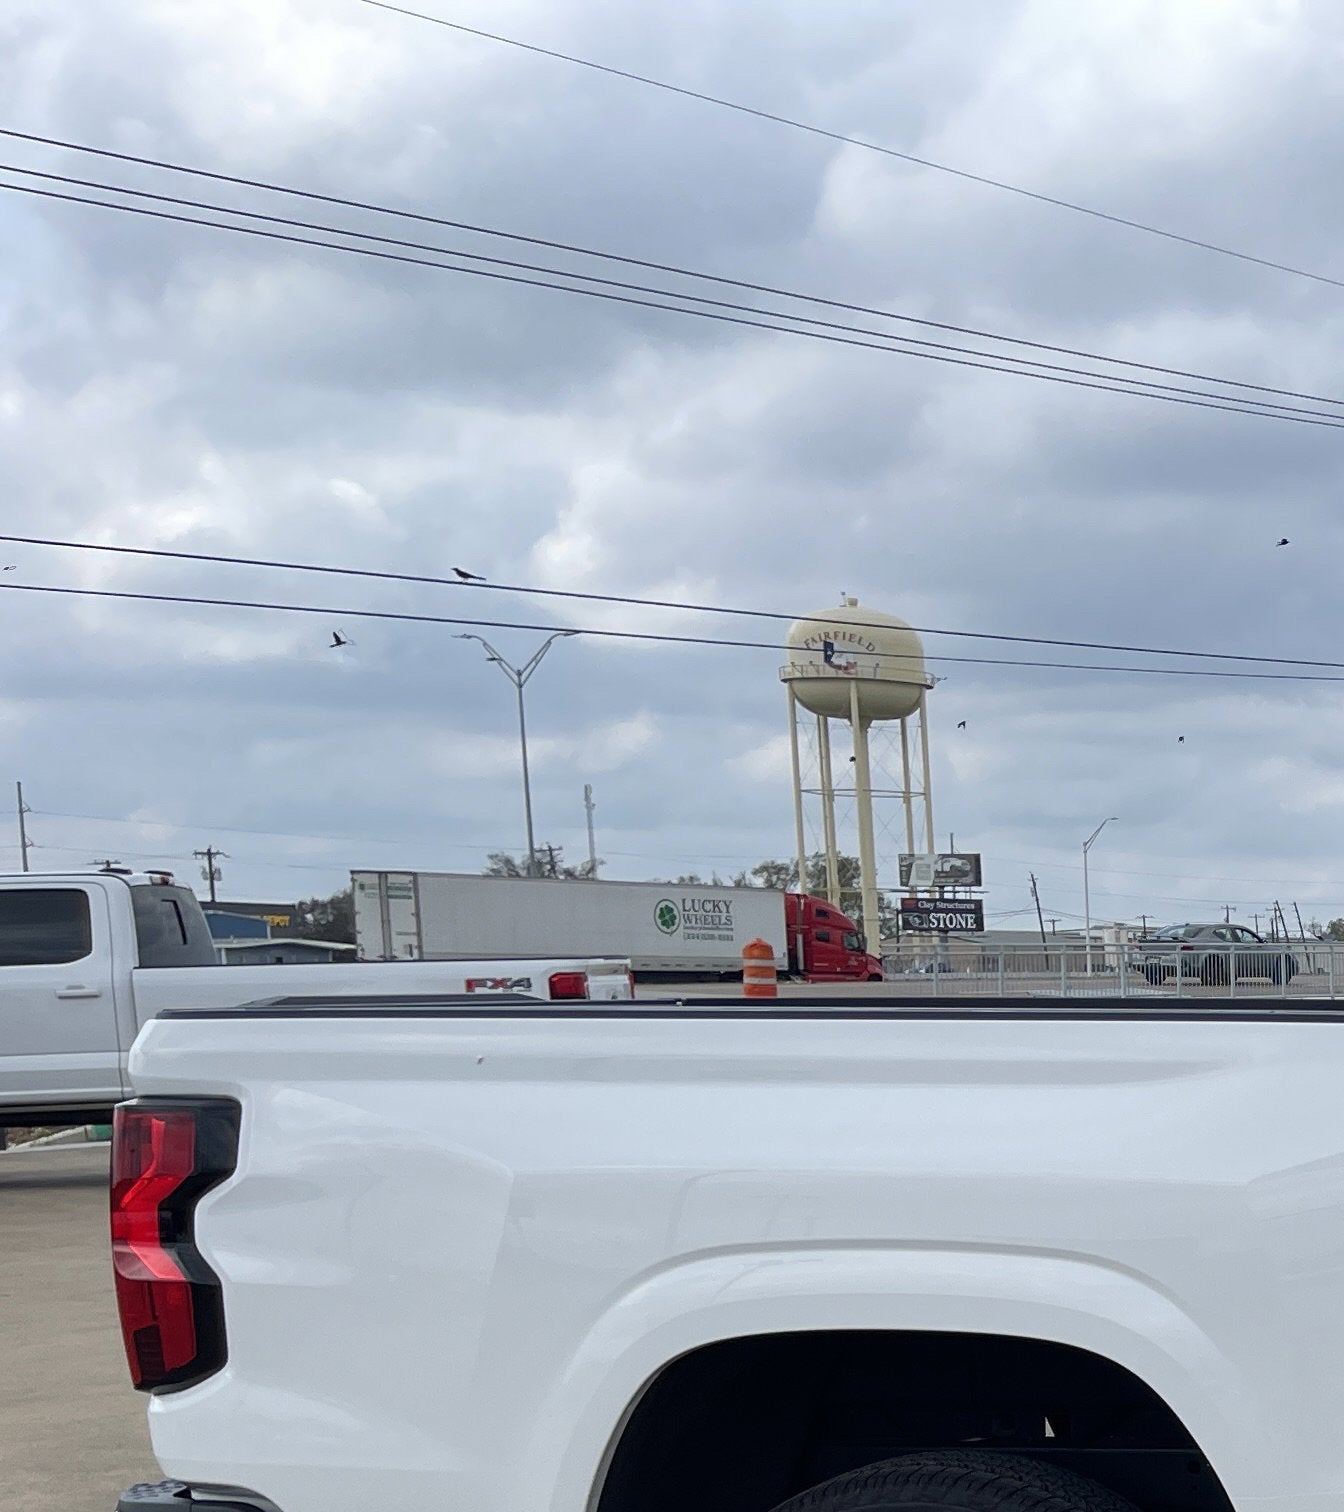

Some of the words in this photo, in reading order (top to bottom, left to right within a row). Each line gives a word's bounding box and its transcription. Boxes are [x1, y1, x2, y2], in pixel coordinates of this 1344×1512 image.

[803, 631, 876, 653] FAIRFIELD
[681, 898, 732, 914] LUCKY
[918, 900, 935, 911] Clay
[682, 913, 733, 927] WHEELS
[929, 912, 977, 929] STONE
[465, 977, 532, 993] FX4
